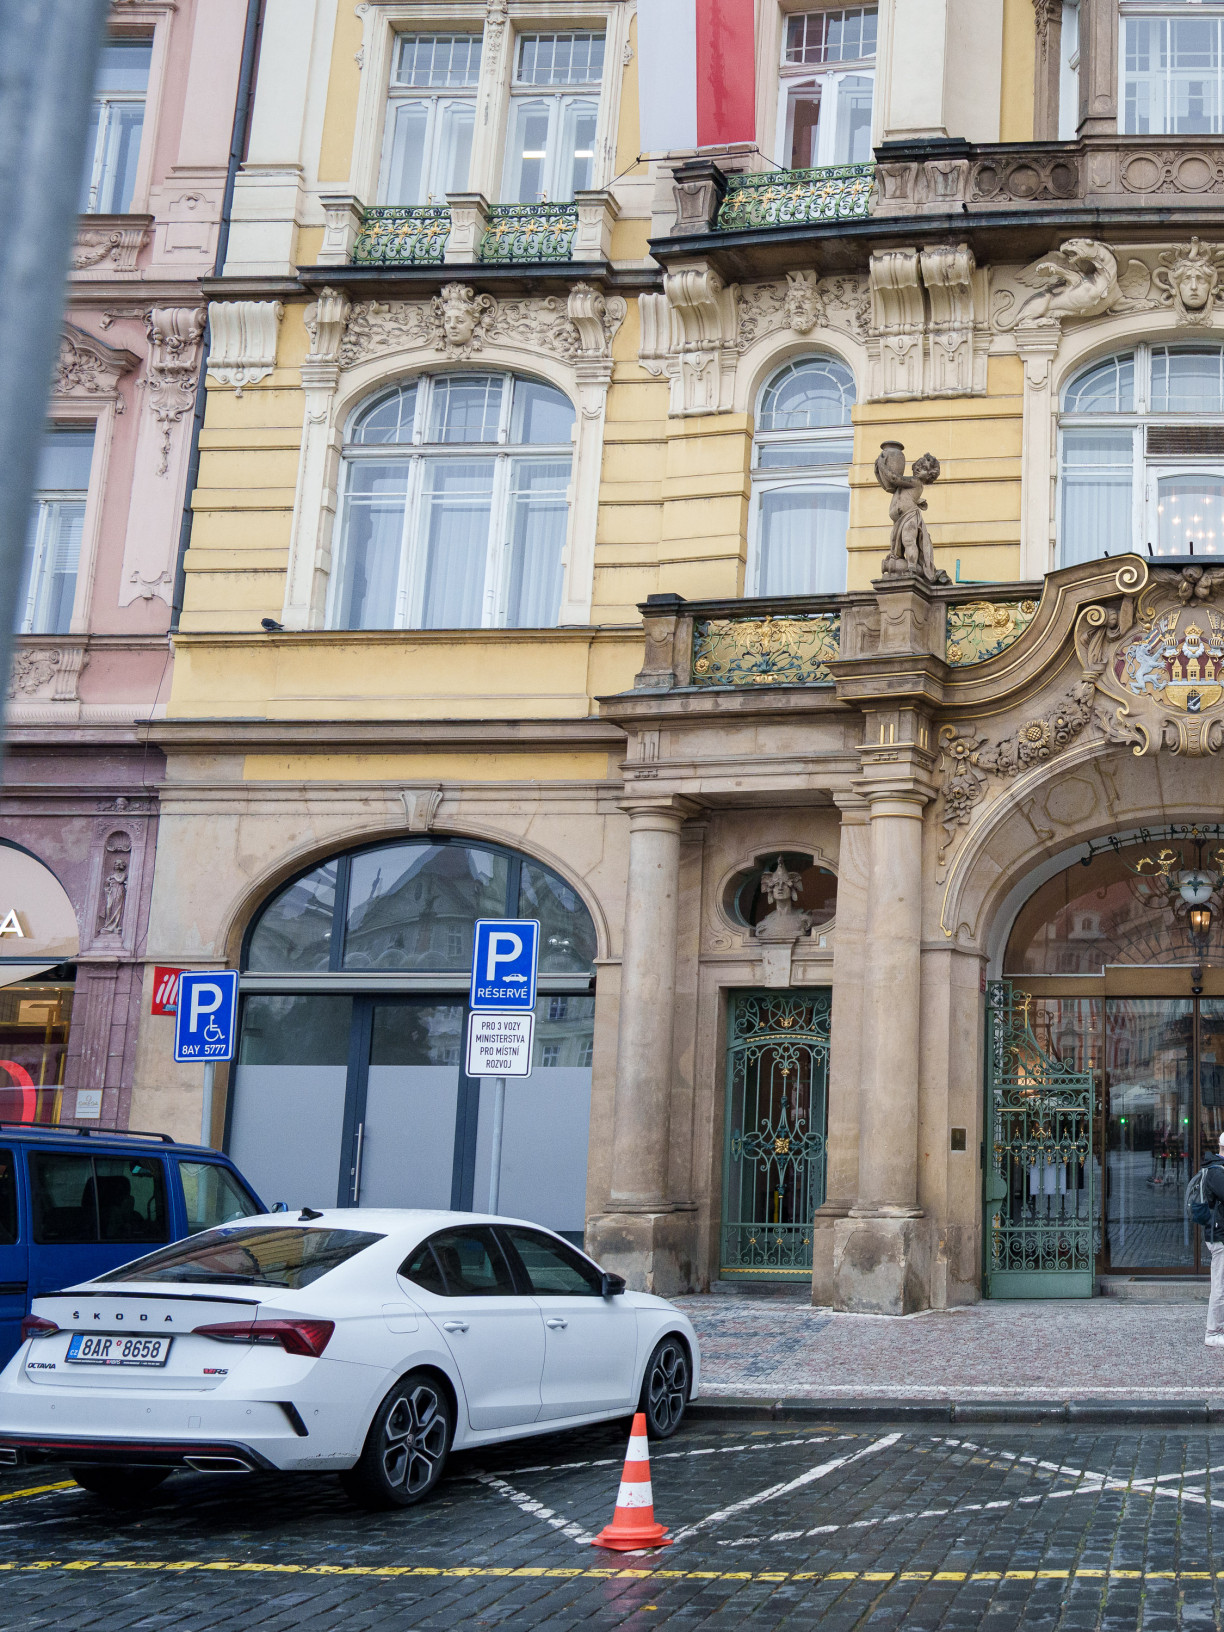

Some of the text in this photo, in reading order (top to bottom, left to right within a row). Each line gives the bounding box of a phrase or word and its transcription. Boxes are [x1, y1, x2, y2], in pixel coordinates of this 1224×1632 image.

[486, 931, 523, 981] P
[477, 985, 529, 998] RÉSERVÉ
[189, 982, 223, 1033] P
[481, 1021, 521, 1031] PRO 3 VOZY
[475, 1034, 525, 1043] MINISTERSTVA
[181, 1044, 226, 1055] 8AY 5777
[480, 1045, 521, 1056] PRO MÍSTNÍ
[485, 1059, 512, 1069] ROZVOJ
[72, 1310, 173, 1322] ŠKODA
[82, 1338, 162, 1359] 8AR 8658
[27, 1362, 56, 1370] OCTAVIA
